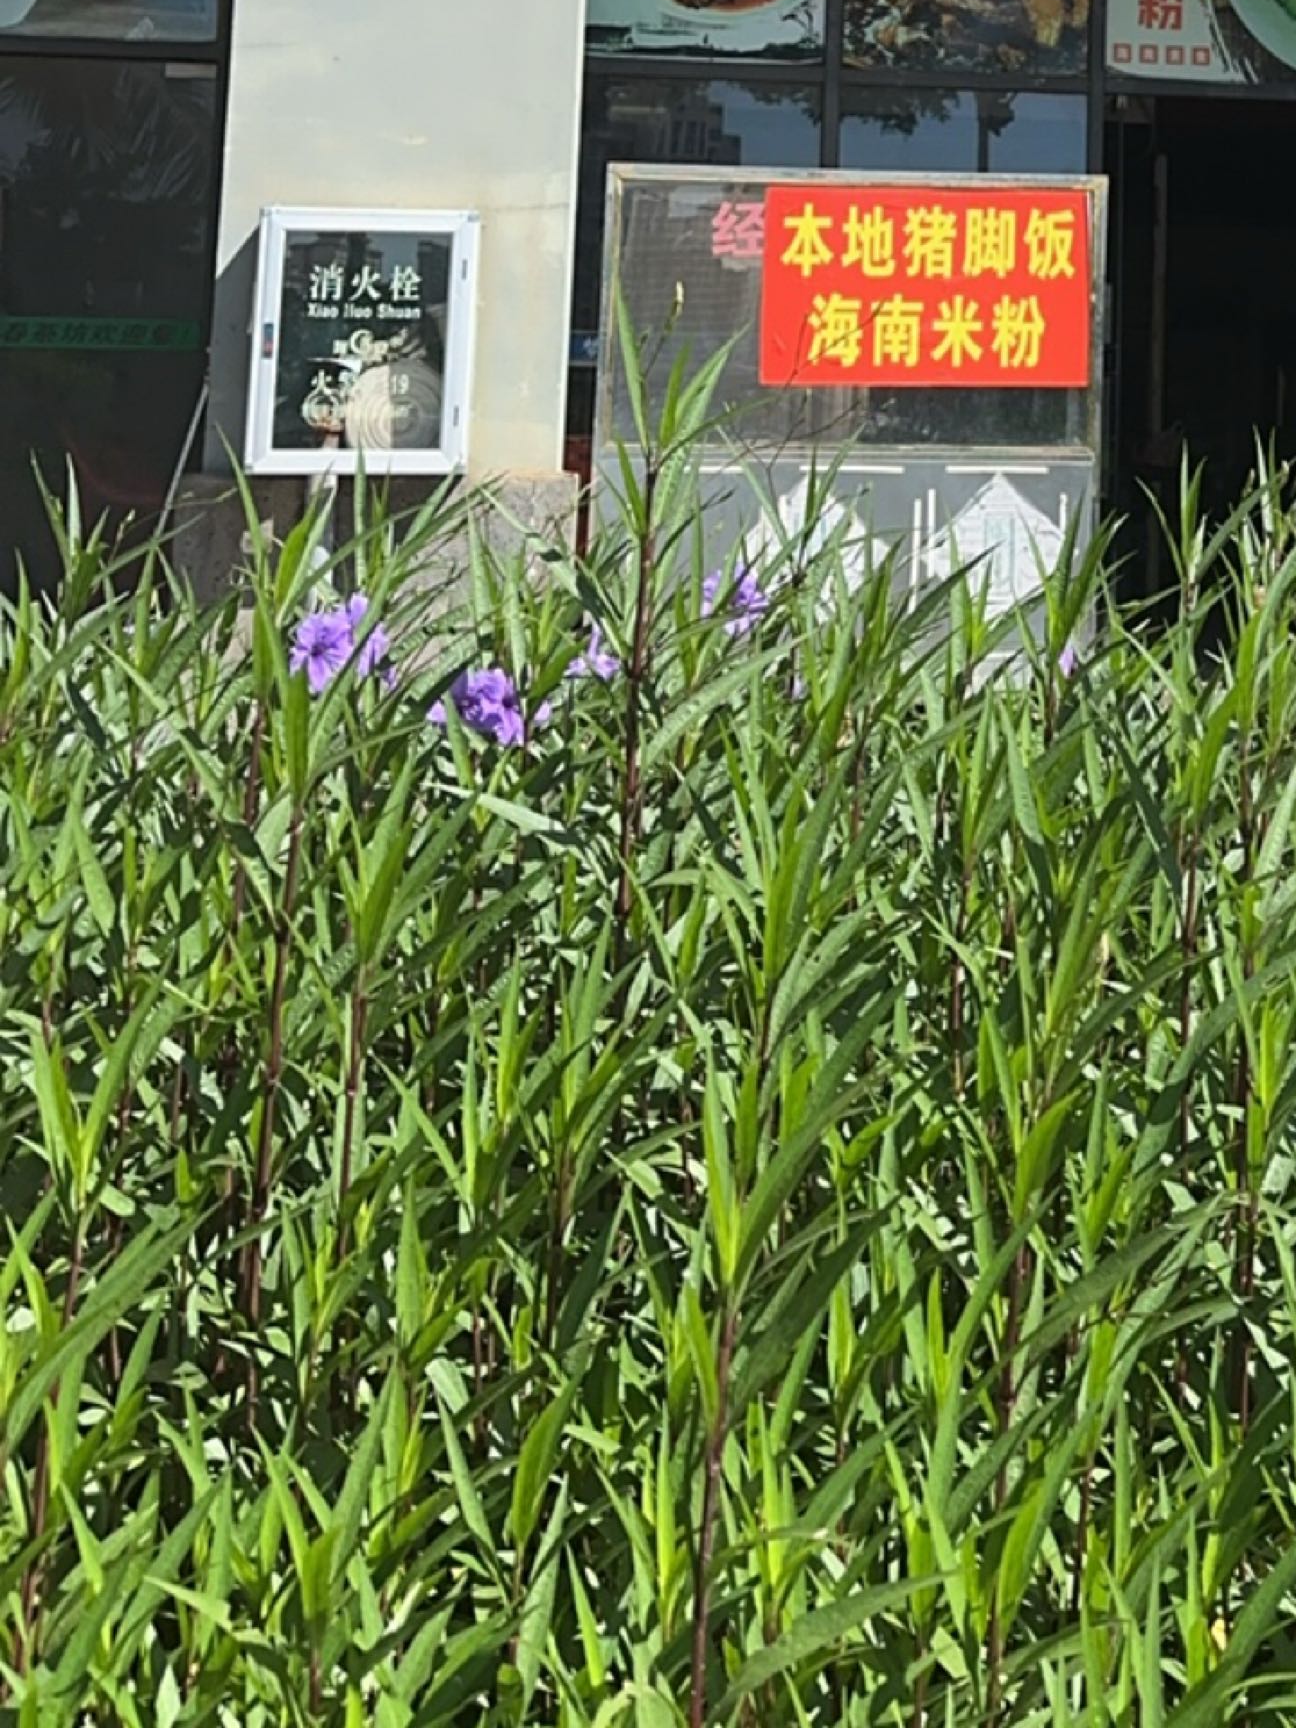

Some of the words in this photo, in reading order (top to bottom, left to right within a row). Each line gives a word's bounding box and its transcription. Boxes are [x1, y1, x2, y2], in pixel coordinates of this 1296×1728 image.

[781, 202, 1075, 279] 本地猪脚饭
[309, 263, 423, 301] 消火栓
[307, 303, 339, 318] Xiao
[376, 303, 421, 318] Shuan
[806, 293, 1046, 368] 海南米粉
